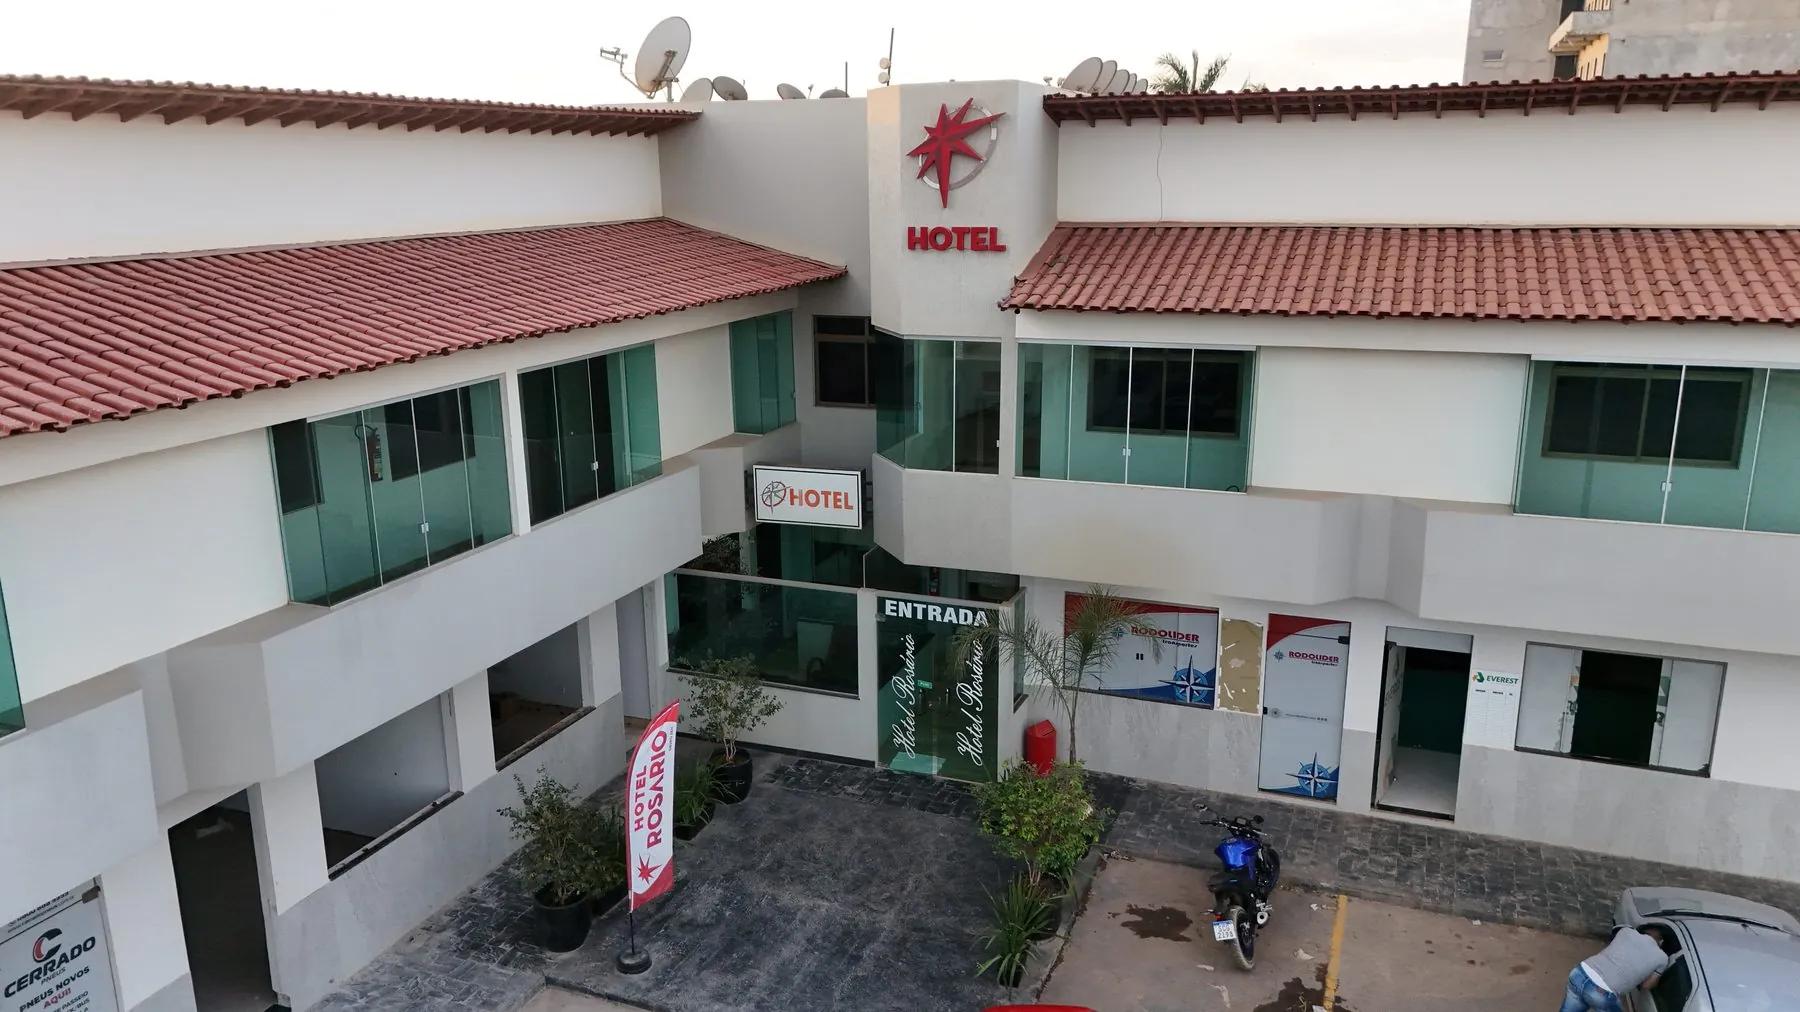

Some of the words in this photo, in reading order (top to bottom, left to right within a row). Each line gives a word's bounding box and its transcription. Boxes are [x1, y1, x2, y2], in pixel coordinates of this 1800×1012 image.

[907, 226, 1006, 252] HOTEL
[789, 487, 854, 510] HOTEL
[884, 599, 988, 628] ENTRADA
[1131, 626, 1199, 642] RODOLIDER
[1288, 651, 1339, 663] RODOLIDER
[1486, 675, 1519, 685] EVEREST
[891, 701, 915, 759] Hotel
[956, 708, 983, 766] Hotel
[634, 765, 647, 832] HOTEL
[646, 730, 668, 849] ROSARIO
[4, 936, 96, 998] CERRADO
[41, 967, 66, 985] PNEUS
[19, 988, 54, 1012] PNEUS
[56, 966, 90, 991] NOVOS
